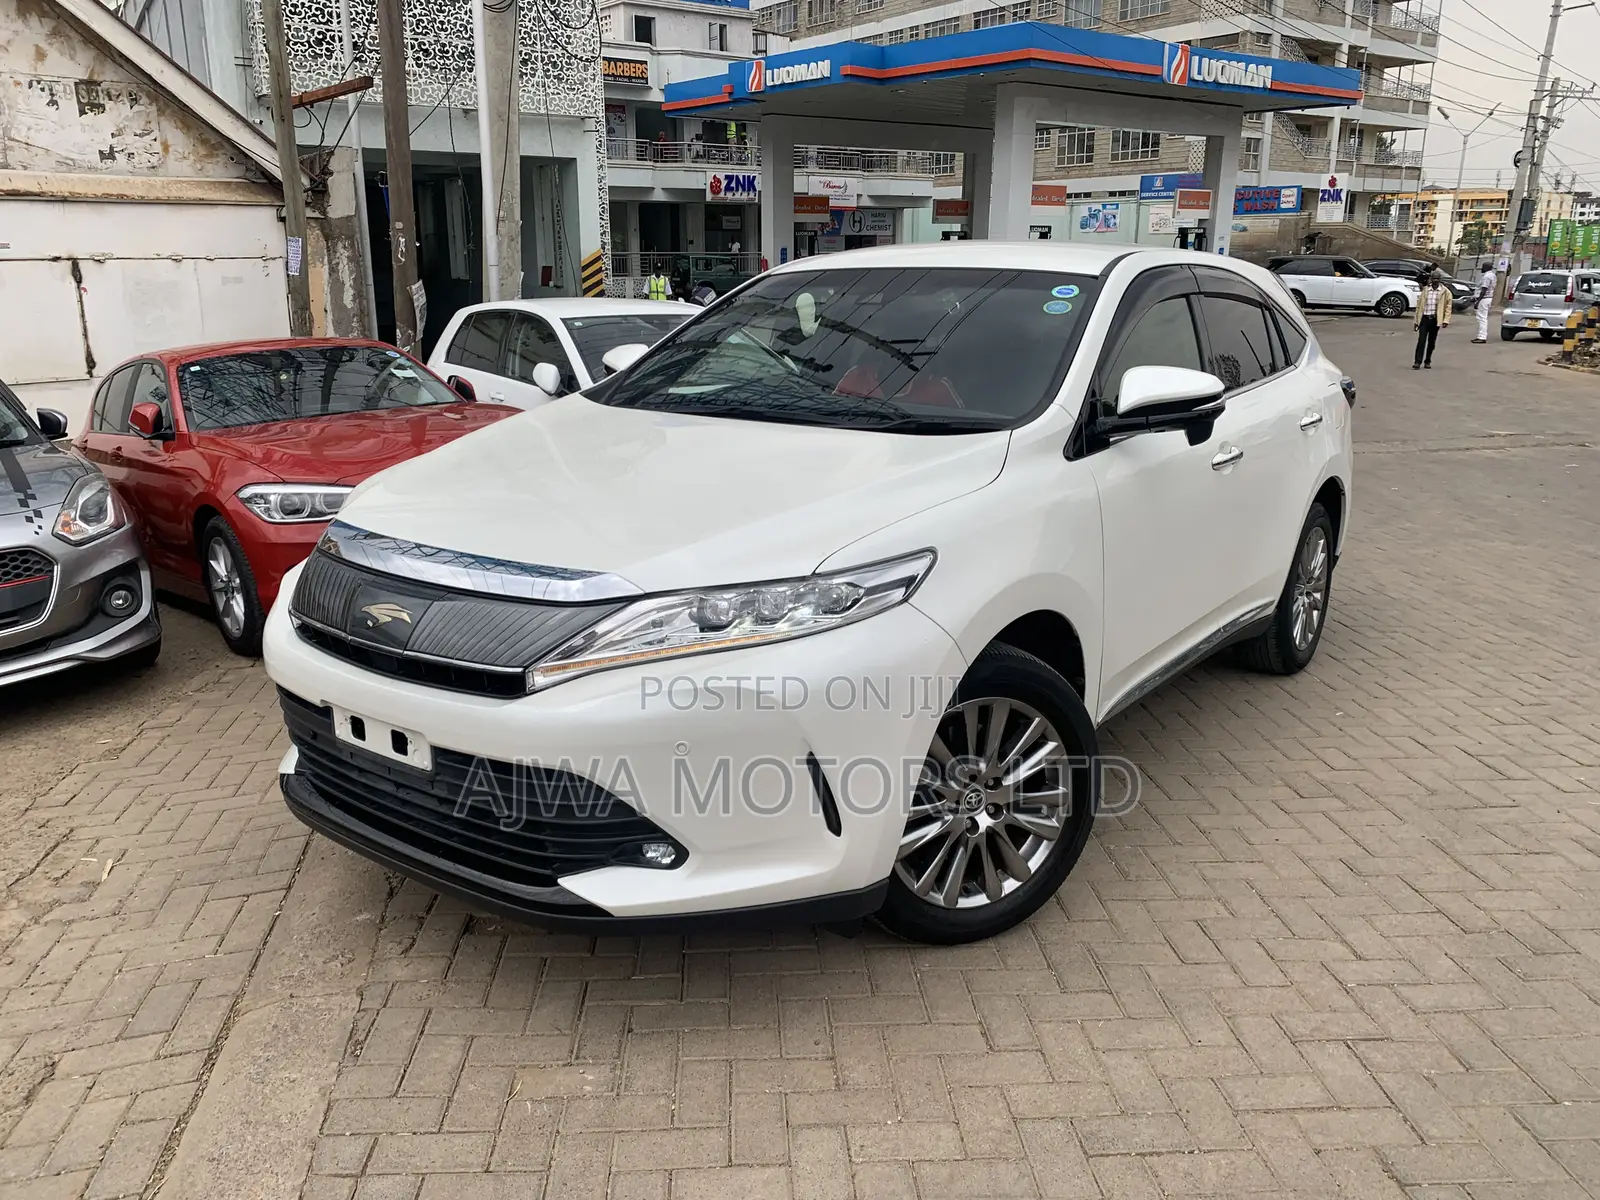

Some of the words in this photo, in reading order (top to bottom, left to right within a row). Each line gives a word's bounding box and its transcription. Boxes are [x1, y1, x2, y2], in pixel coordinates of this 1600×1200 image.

[603, 61, 648, 79] BARBERS
[766, 60, 831, 87] LUQMAN
[1191, 56, 1272, 89] LUQMAN
[724, 174, 757, 192] ZNK
[1320, 188, 1343, 203] ZNK
[1244, 200, 1278, 212] WASH
[865, 224, 892, 232] CHEMIST
